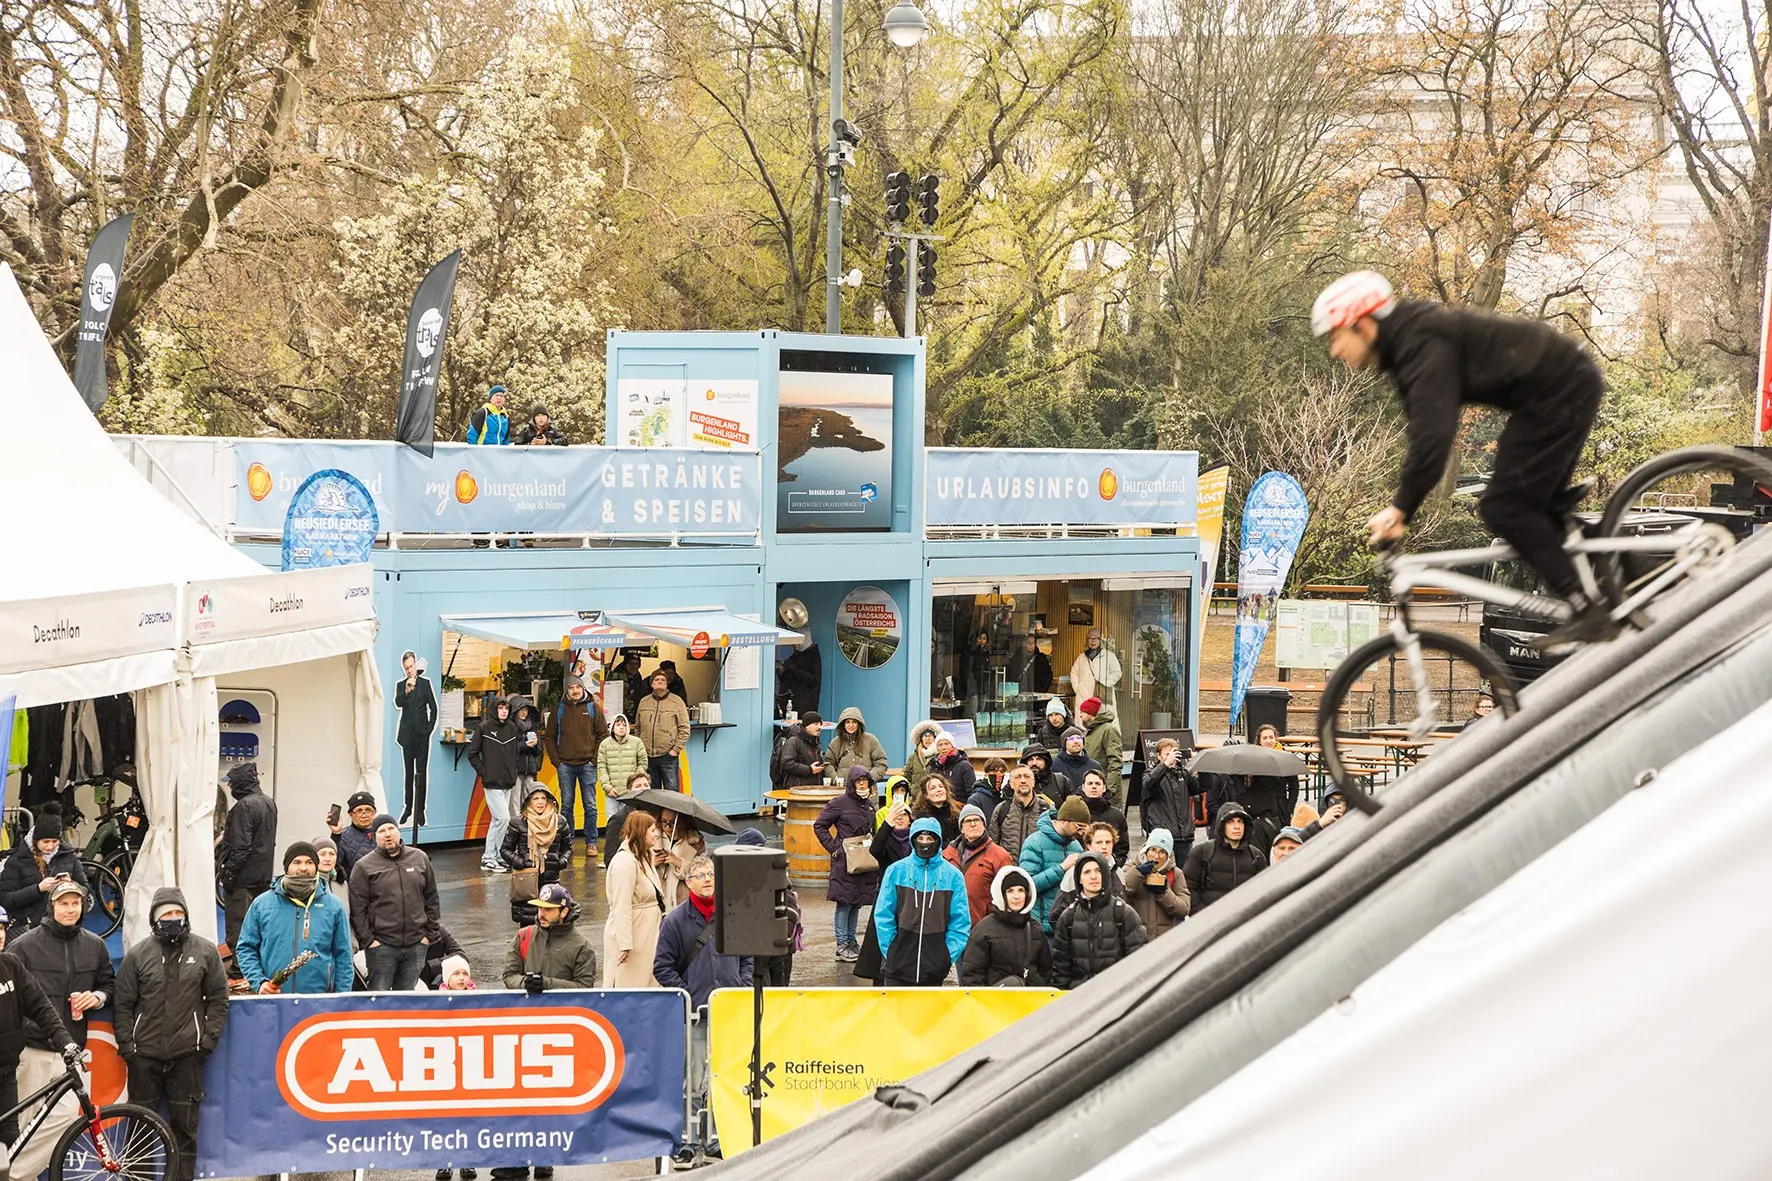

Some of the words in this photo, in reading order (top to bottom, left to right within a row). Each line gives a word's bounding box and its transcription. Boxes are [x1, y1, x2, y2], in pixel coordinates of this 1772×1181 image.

[691, 413, 739, 430] BURGENLAND
[704, 426, 749, 443] HIGHLIGHTS.
[601, 456, 743, 489] GETRÄNKE
[937, 476, 1089, 499] URLAUBSINFO
[1122, 475, 1186, 498] burgenland
[425, 481, 450, 516] my
[483, 478, 567, 502] burgenland
[517, 500, 536, 511] shop
[545, 500, 567, 510] bistro
[601, 498, 616, 524] &
[633, 498, 742, 524] SPEISEN
[1249, 507, 1306, 519] NEUSIEDLERSEE
[294, 517, 370, 531] NEUSIEDLERSEE
[269, 592, 304, 613] Decathlon
[857, 603, 885, 612] LÄNGSTE
[145, 612, 173, 624] DECATHLON
[854, 618, 895, 627] ÖSTERREICHS
[858, 612, 893, 620] RADSAISON
[33, 619, 80, 643] Decathlon
[572, 636, 624, 646] PFANDRÜCKGABE
[731, 635, 775, 645] BESTELLUNG
[1509, 646, 1540, 659] MAN
[327, 1033, 575, 1094] ABUS
[785, 1061, 864, 1074] Raiffeisen
[785, 1077, 860, 1090] Stadtbank
[326, 1131, 415, 1156] Security
[420, 1129, 468, 1150] Tech
[477, 1128, 574, 1151] Germany
